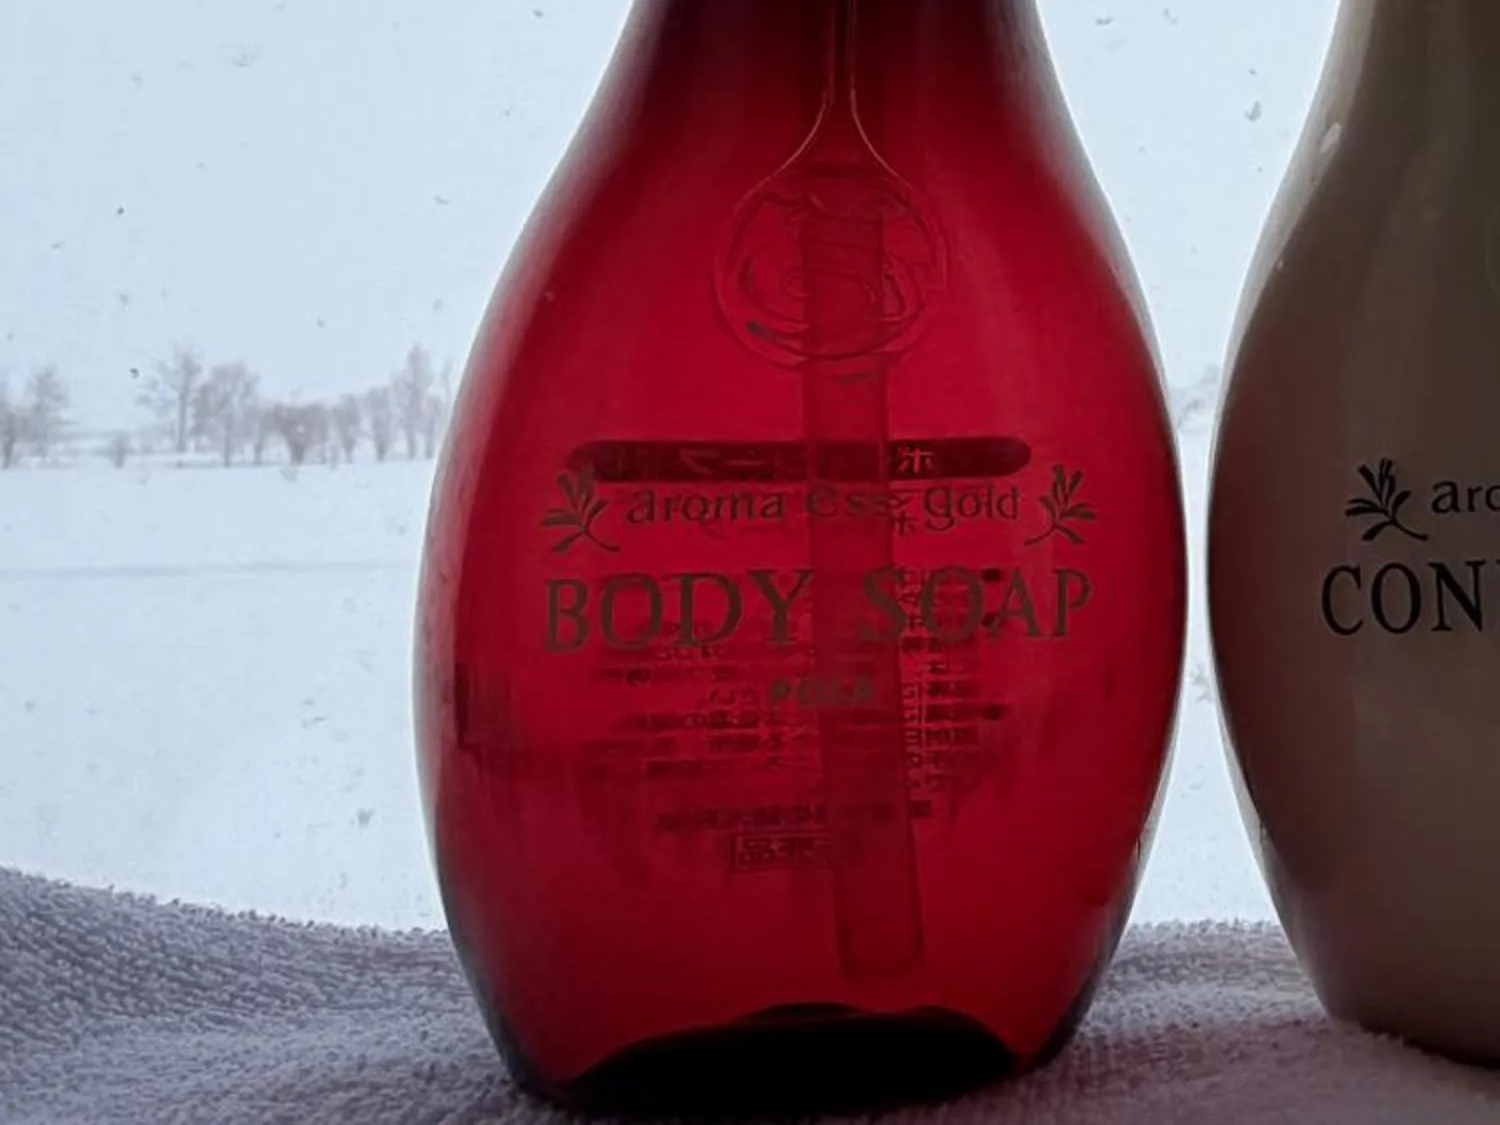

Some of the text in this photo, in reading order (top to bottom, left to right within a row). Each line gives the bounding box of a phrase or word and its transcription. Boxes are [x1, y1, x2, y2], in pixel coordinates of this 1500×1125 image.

[625, 483, 785, 523] aroma
[922, 482, 1021, 533] gold
[542, 566, 1094, 653] BODY SOAP
